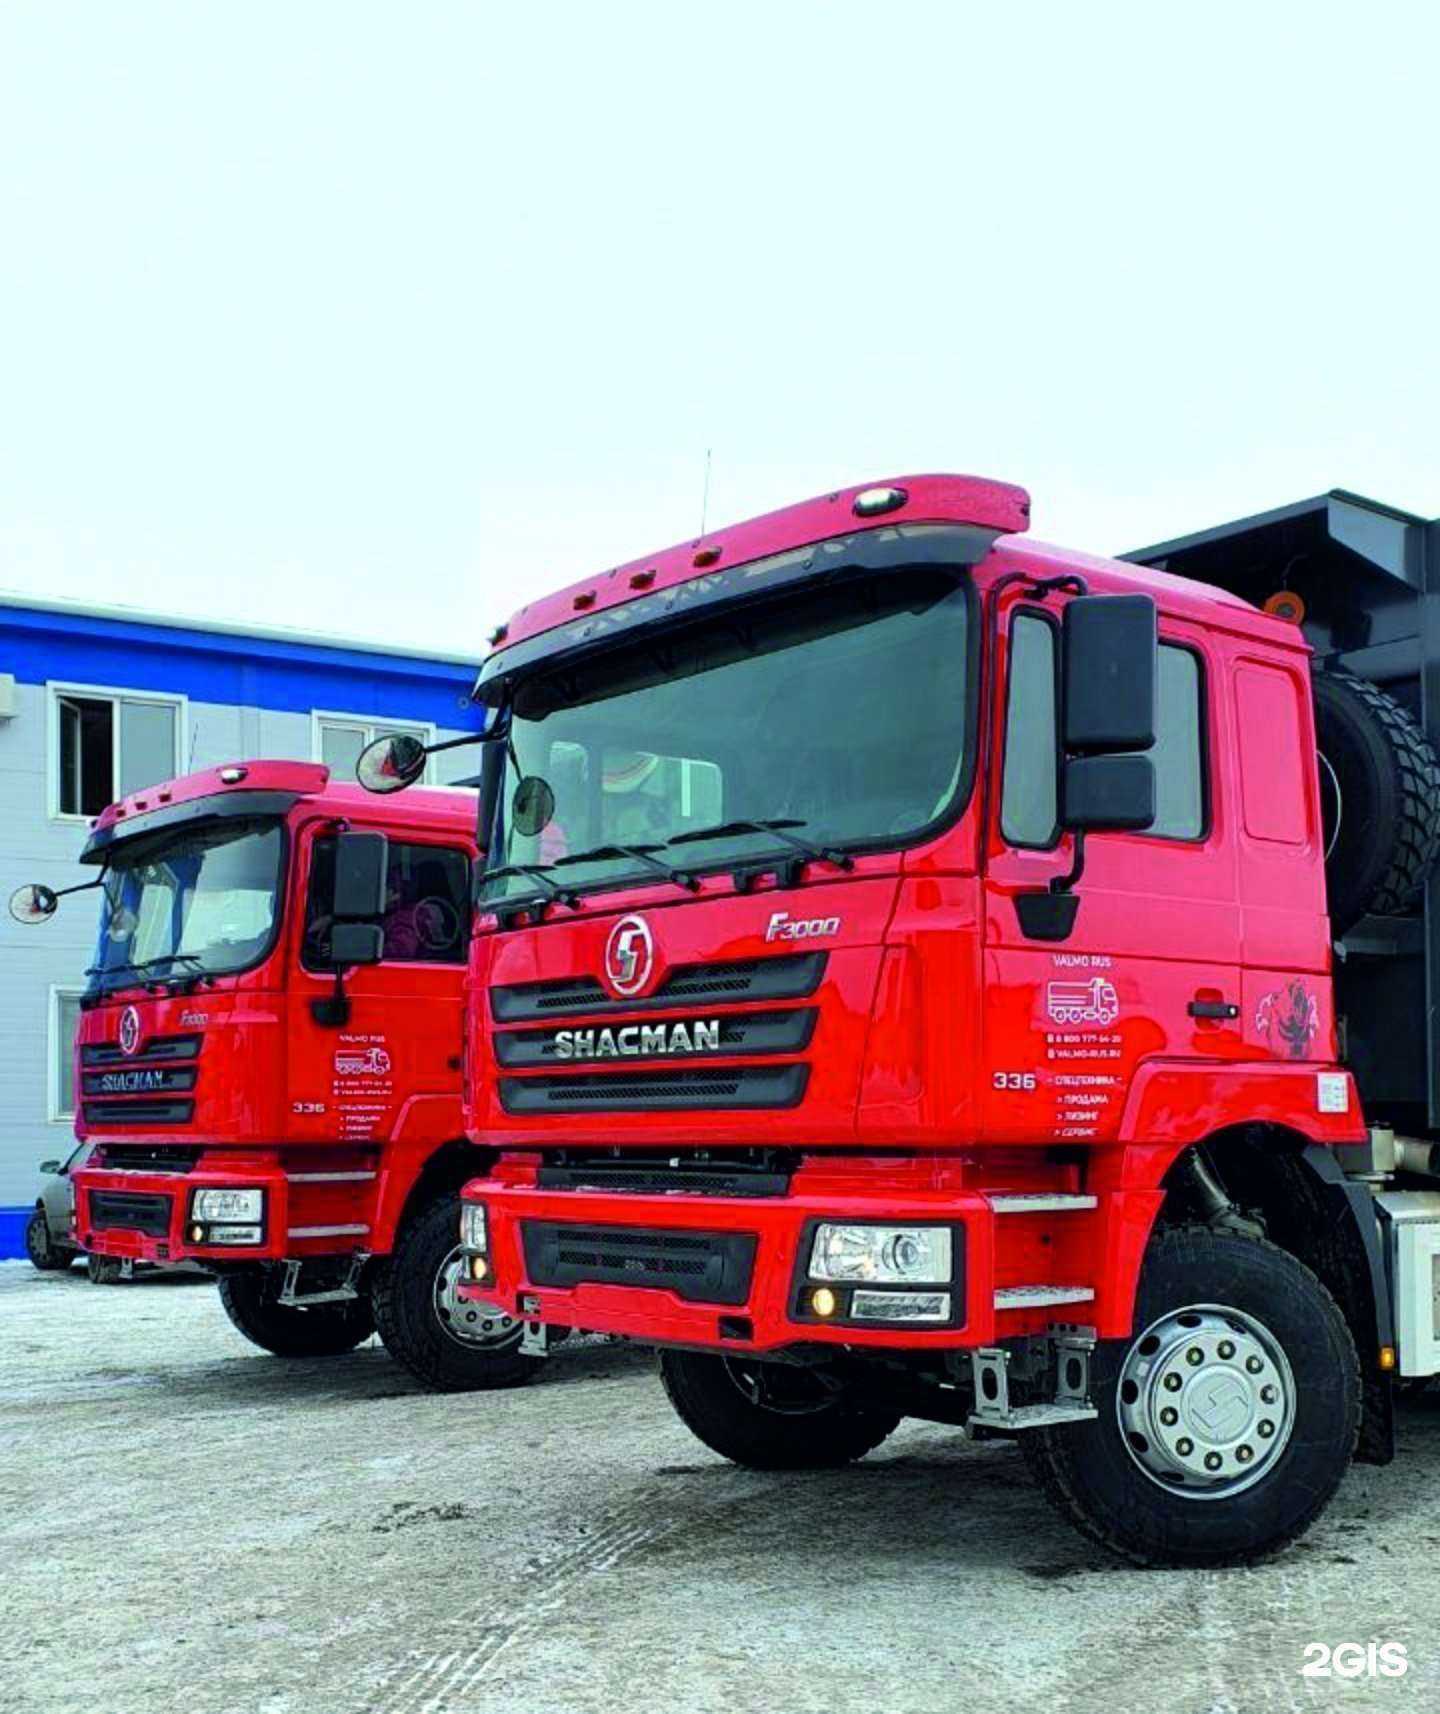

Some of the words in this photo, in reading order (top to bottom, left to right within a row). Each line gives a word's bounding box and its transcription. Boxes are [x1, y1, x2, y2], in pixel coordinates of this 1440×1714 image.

[766, 912, 840, 943] F3000
[1053, 954, 1088, 967] VALMO
[1091, 955, 1111, 967] RUS
[554, 1020, 720, 1059] SHACMAN
[993, 1072, 1036, 1089] 336
[293, 1102, 325, 1113] 336
